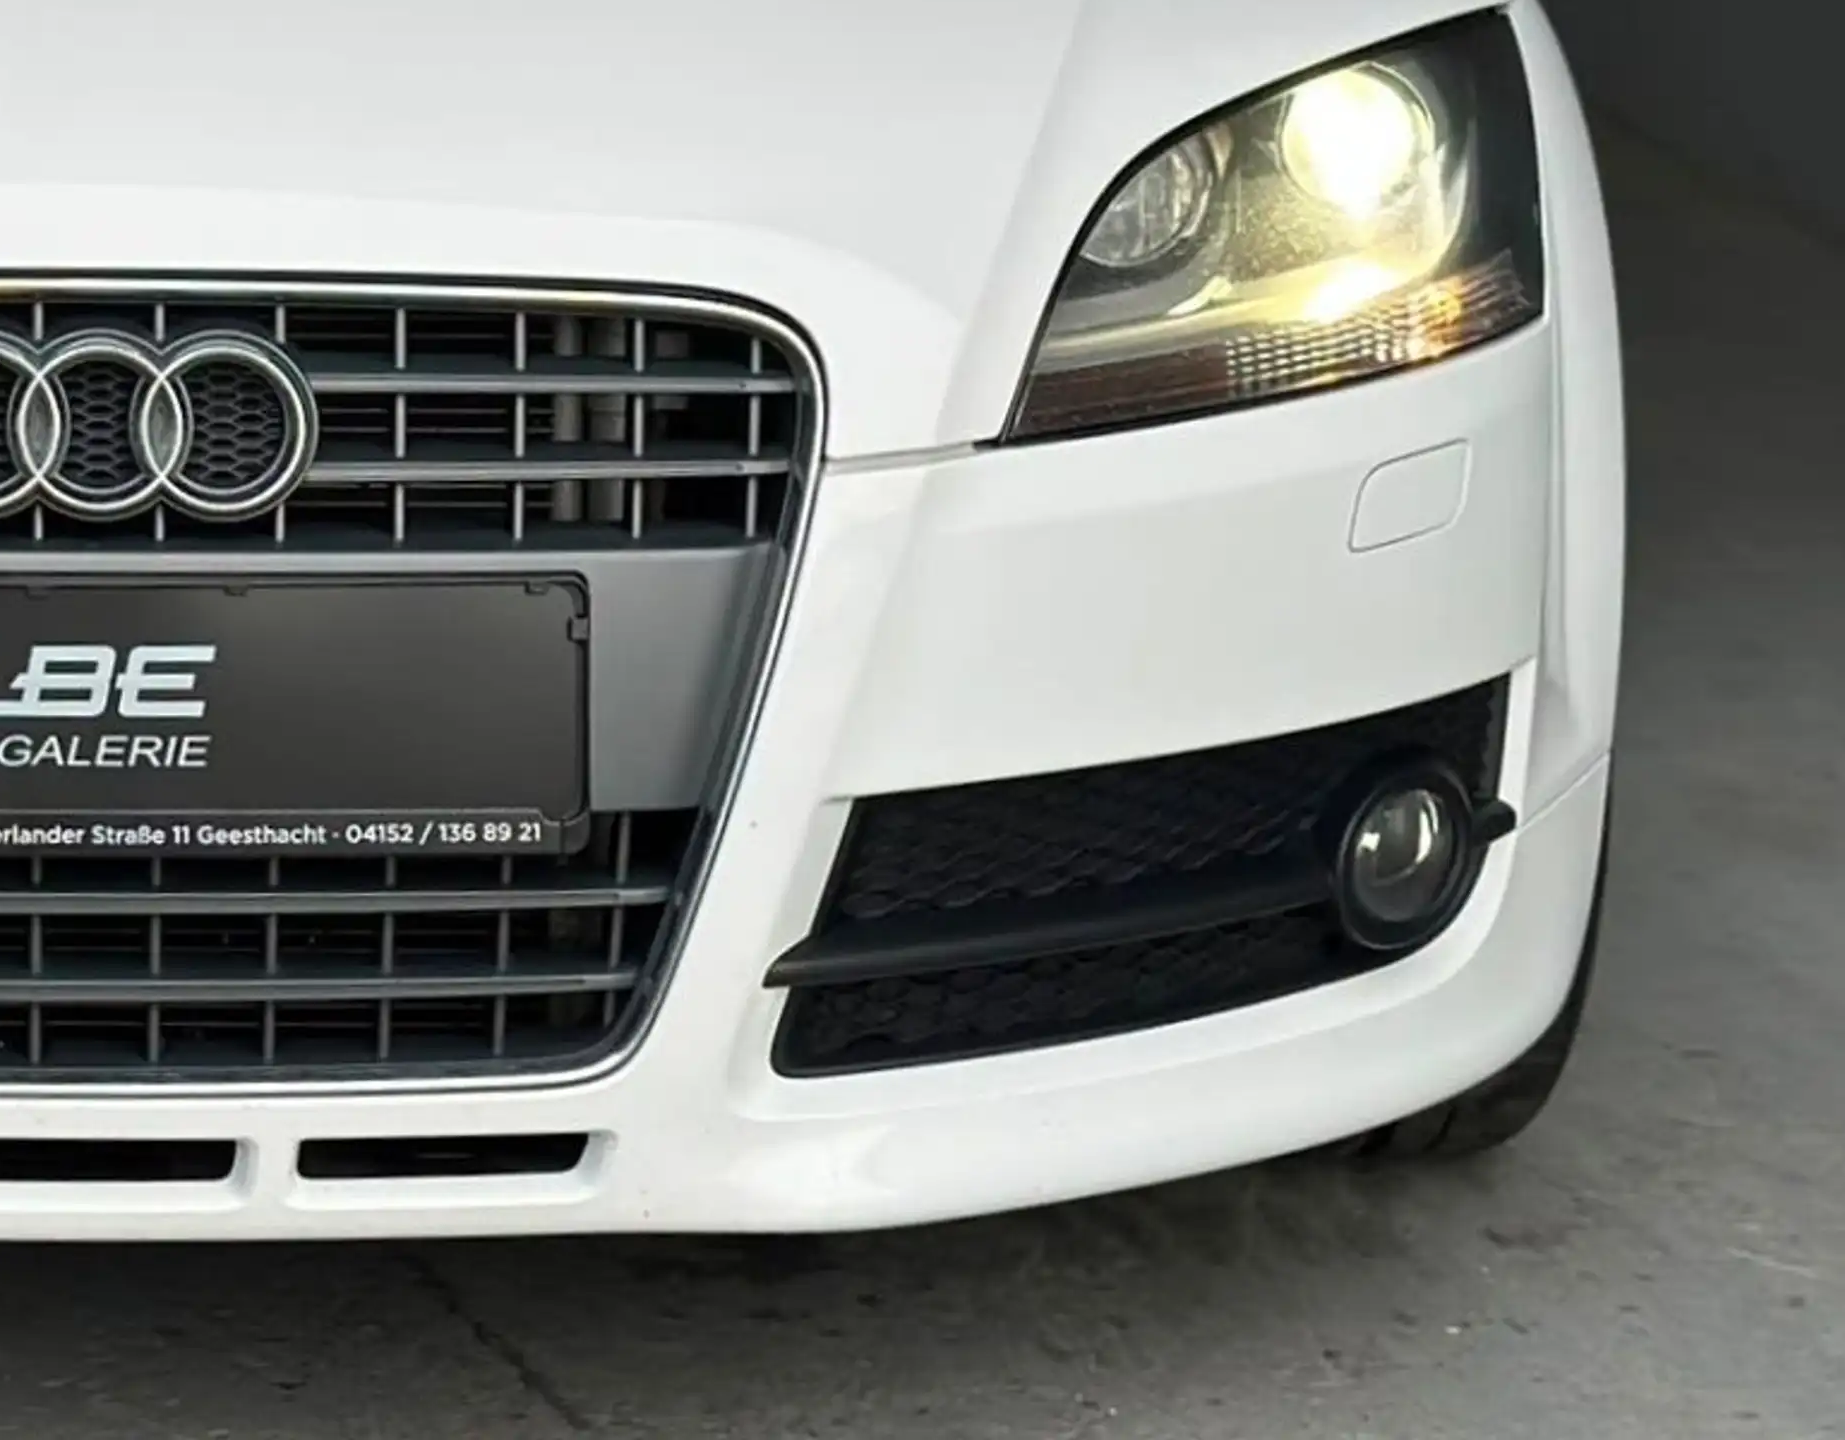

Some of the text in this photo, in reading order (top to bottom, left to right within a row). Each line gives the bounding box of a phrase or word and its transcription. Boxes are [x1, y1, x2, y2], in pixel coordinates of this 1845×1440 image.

[91, 823, 166, 845] Straße
[171, 824, 191, 845] 11
[196, 824, 327, 845] Geesthacht
[345, 822, 415, 844] 04152
[438, 822, 477, 844] 136
[482, 822, 512, 843] 89
[517, 821, 542, 843] 21
